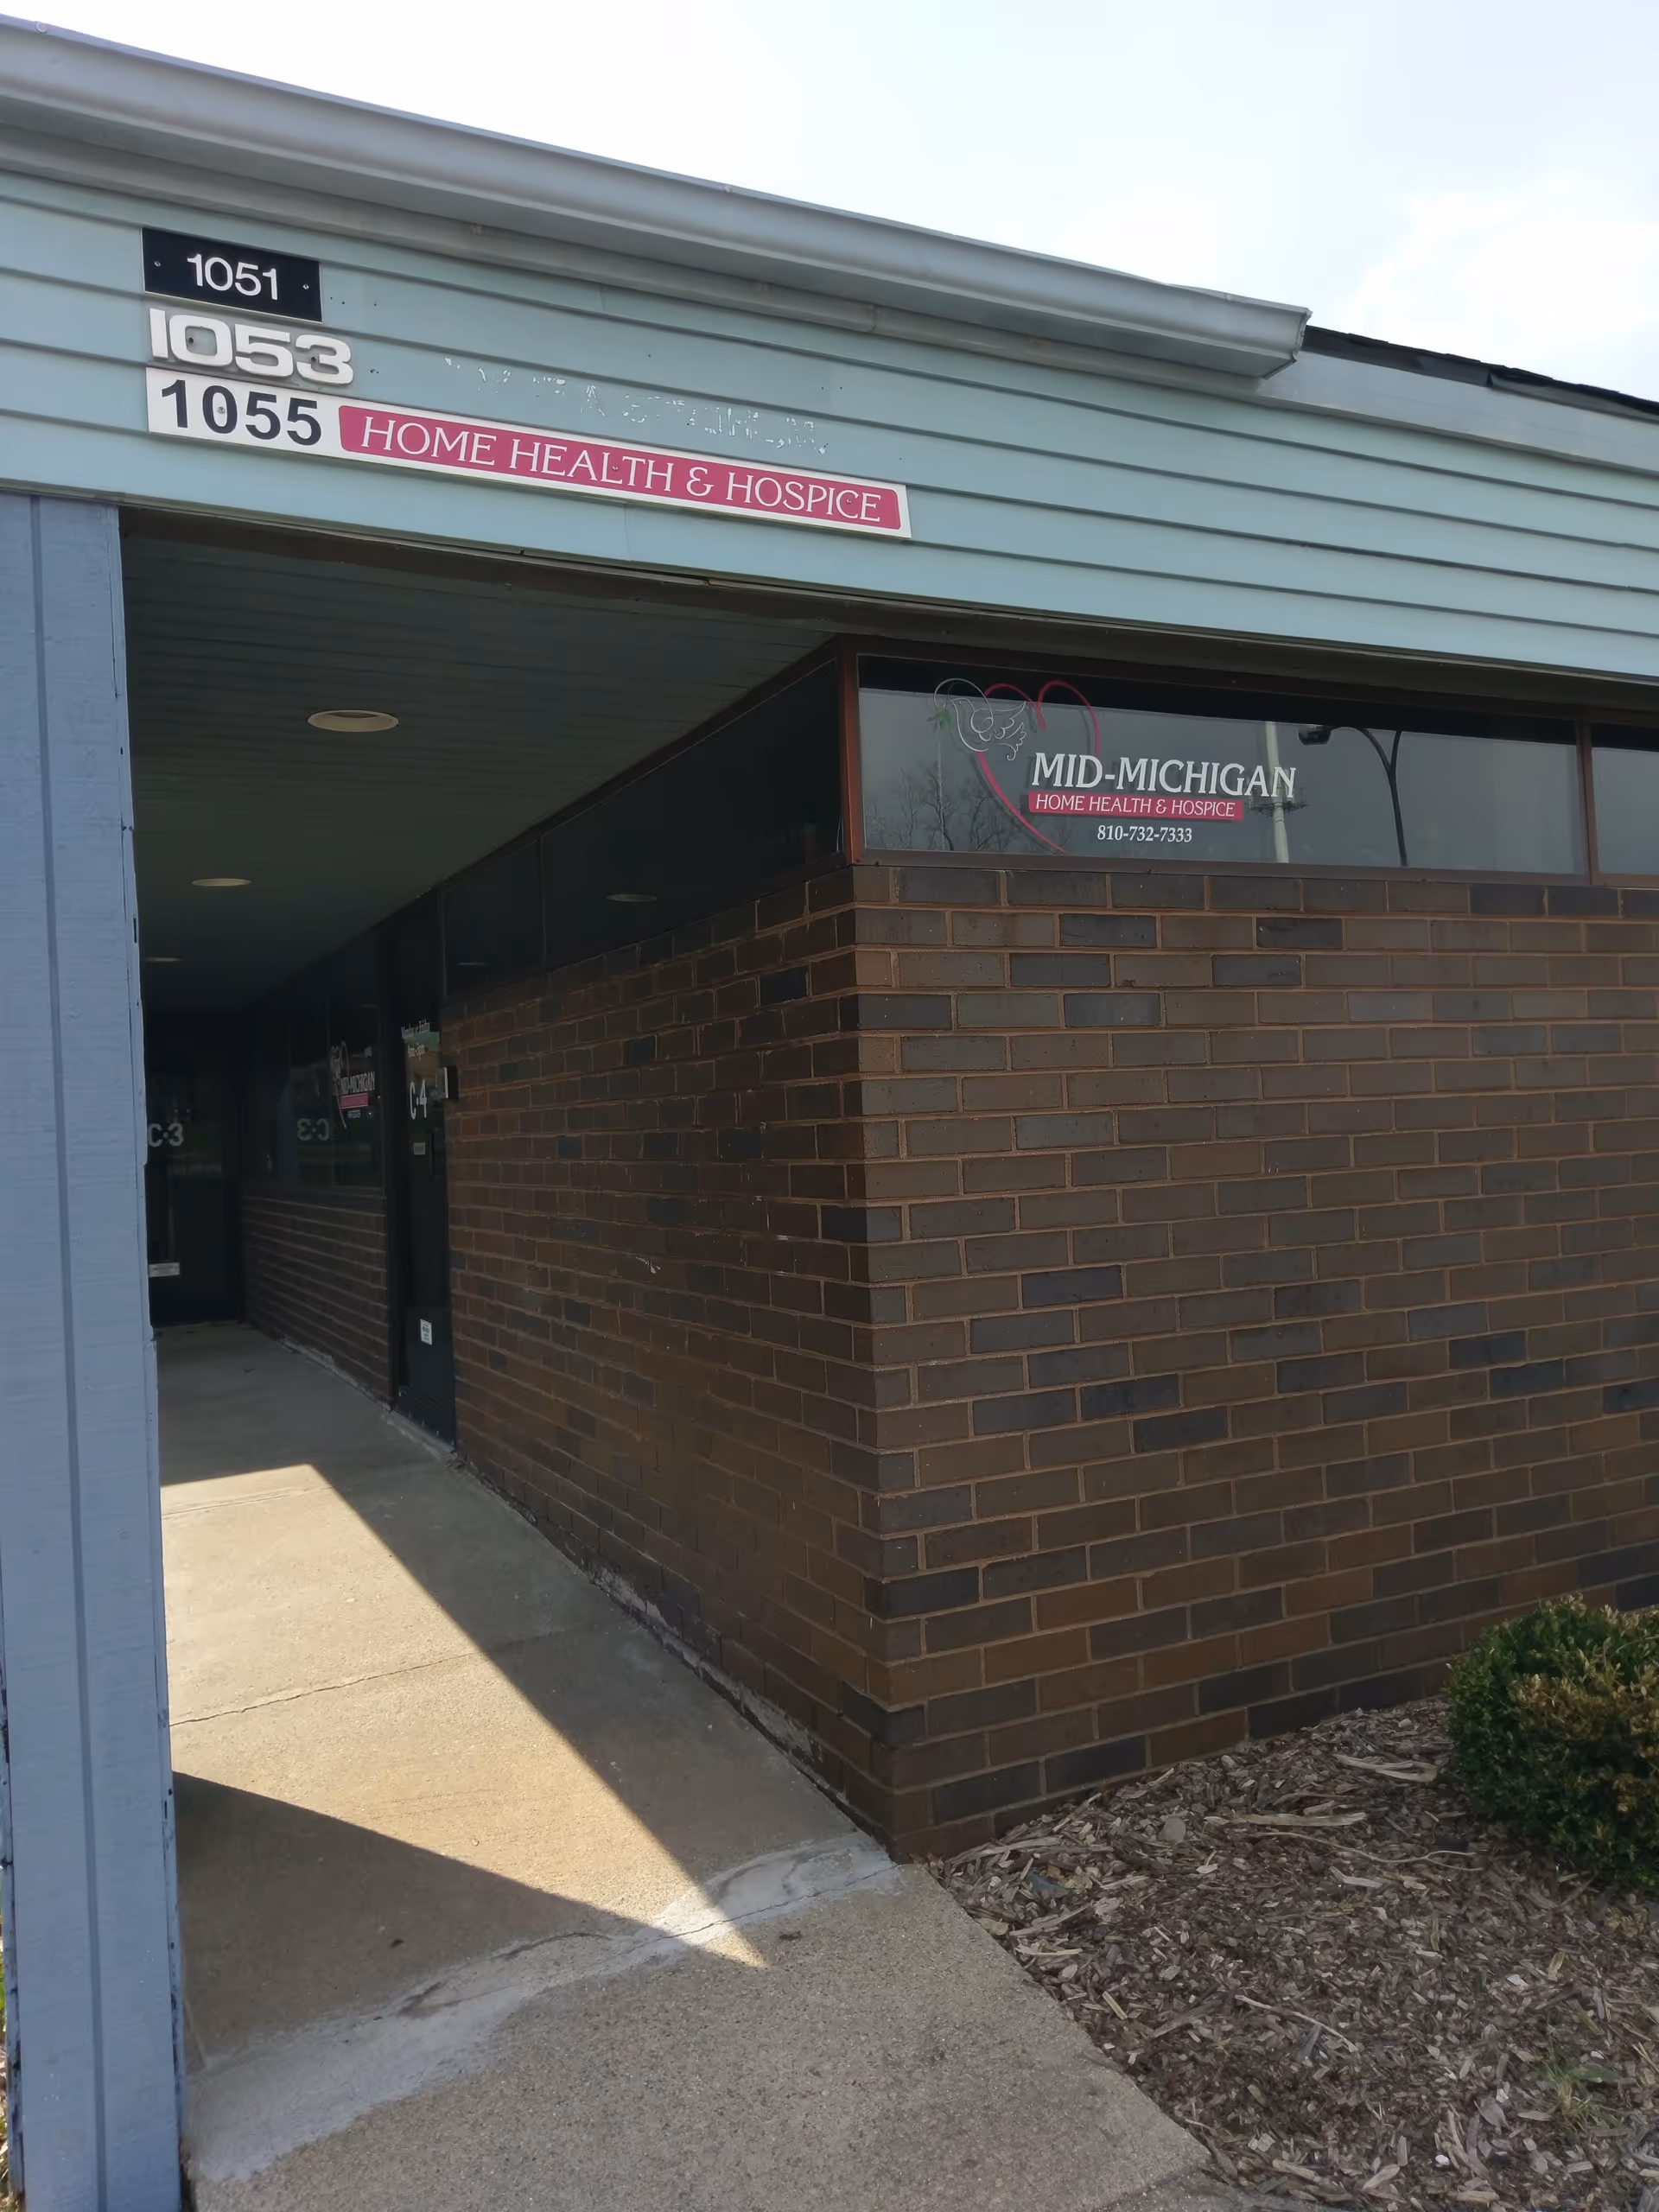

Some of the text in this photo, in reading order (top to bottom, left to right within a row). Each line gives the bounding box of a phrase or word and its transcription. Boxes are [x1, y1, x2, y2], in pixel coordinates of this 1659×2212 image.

[187, 253, 278, 301] 1051
[149, 308, 354, 385] 1053
[161, 379, 882, 523] 1055 HOME HEALTH & HOSPICE
[1031, 753, 1296, 798] MID-MICHIGAN
[1035, 793, 1236, 817] HOME HEALTH & HOSPICE
[1096, 824, 1192, 843] 810-732-7333
